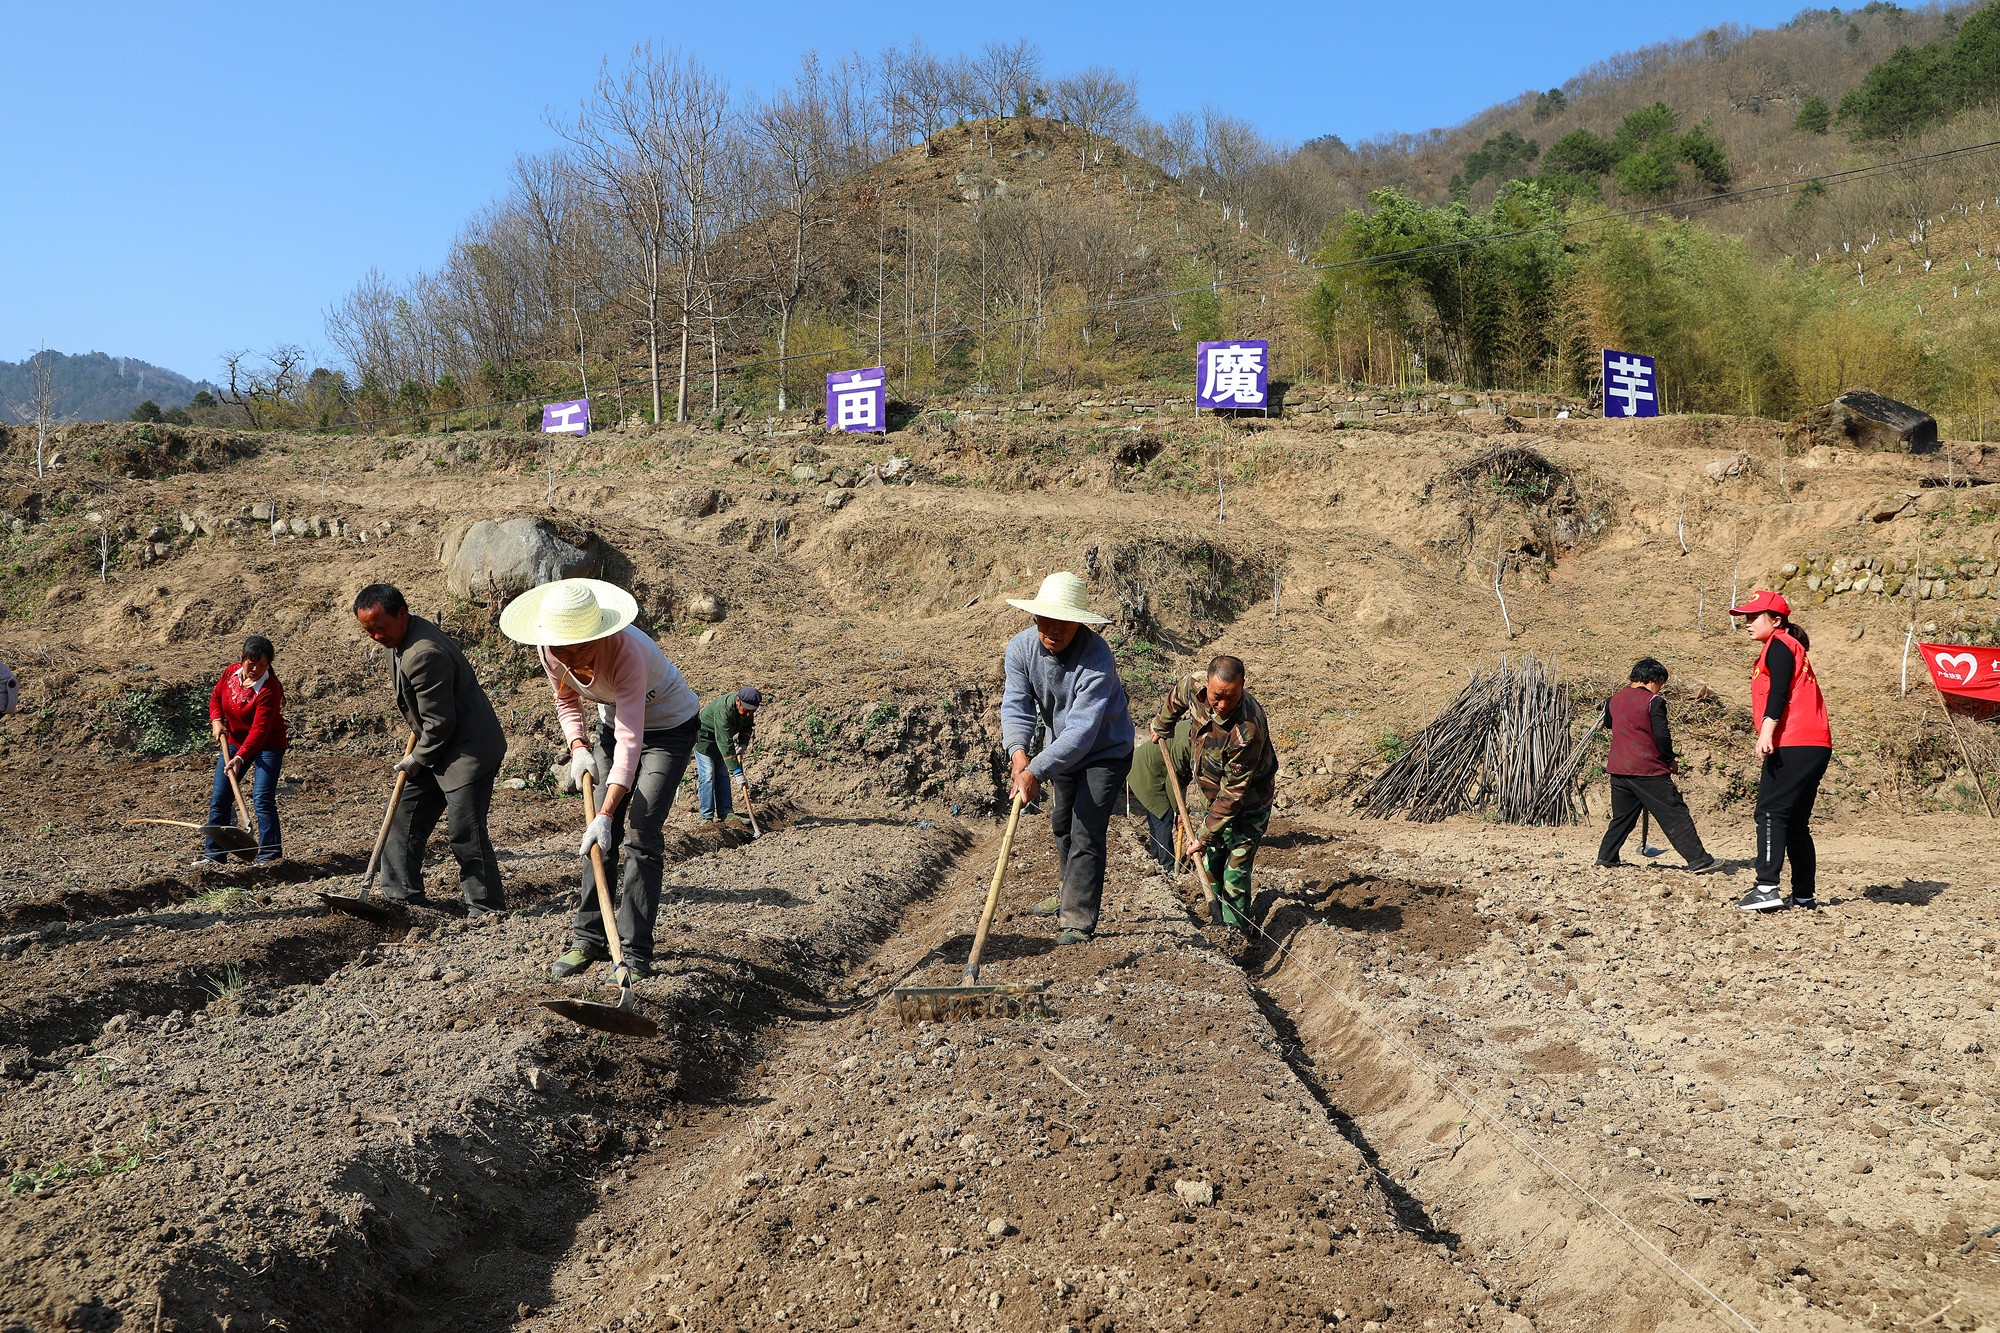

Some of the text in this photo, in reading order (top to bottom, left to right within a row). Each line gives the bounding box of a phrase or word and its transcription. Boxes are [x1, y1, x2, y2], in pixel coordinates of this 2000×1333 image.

[832, 373, 881, 429] 亩
[1201, 344, 1263, 403] 魔
[1609, 356, 1653, 416] 芋
